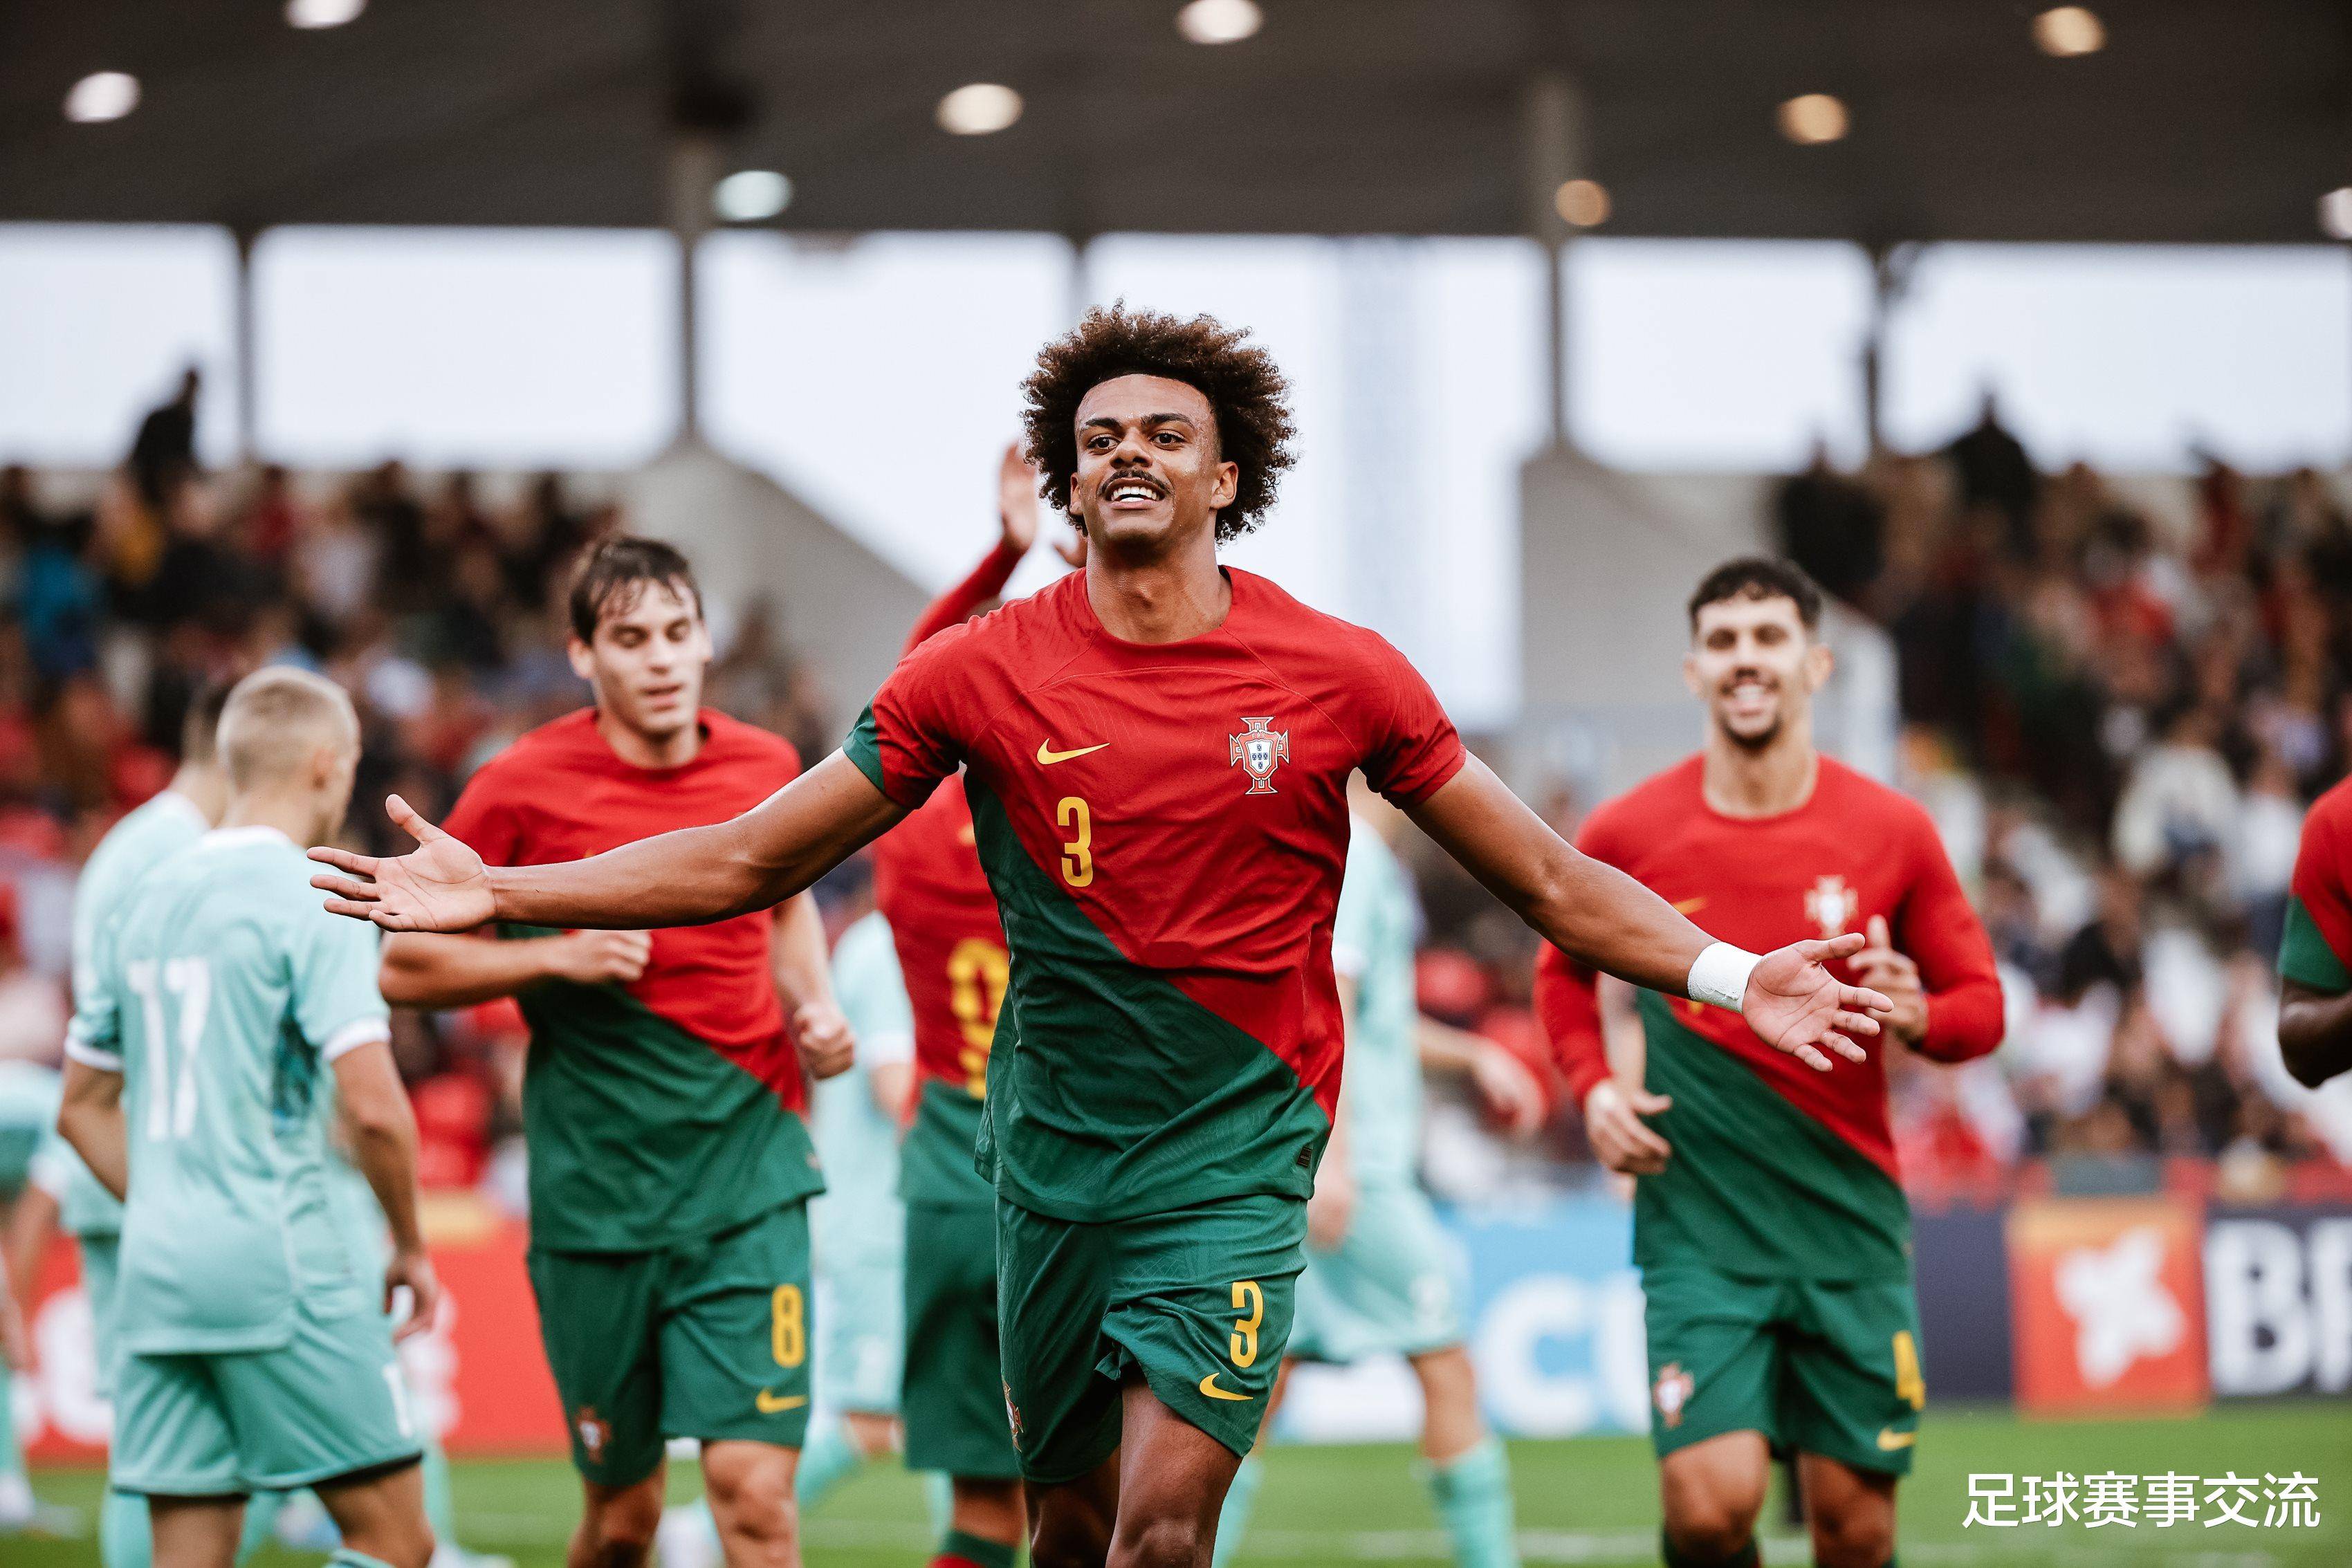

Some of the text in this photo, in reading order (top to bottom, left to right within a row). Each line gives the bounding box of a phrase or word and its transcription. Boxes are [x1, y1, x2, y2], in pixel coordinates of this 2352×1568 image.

[1056, 796, 1094, 887] 3
[127, 957, 211, 1141] 17
[771, 1283, 805, 1369] 8
[1230, 1280, 1264, 1368] 3
